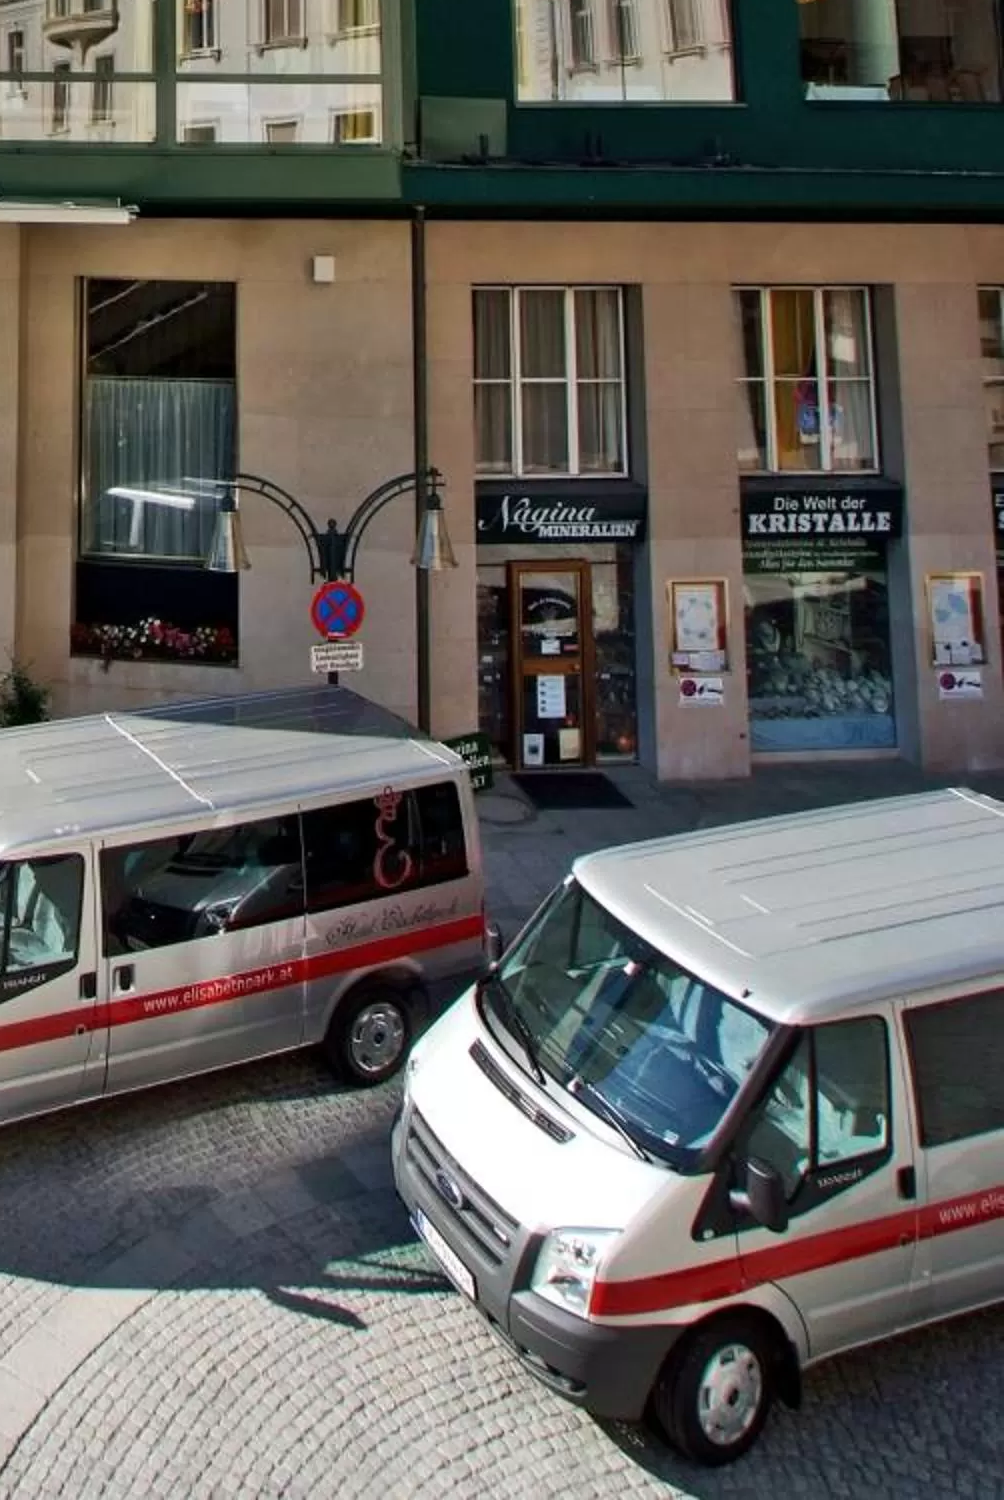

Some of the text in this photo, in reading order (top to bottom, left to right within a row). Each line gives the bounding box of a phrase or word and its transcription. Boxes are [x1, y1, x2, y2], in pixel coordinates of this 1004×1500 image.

[478, 495, 596, 533] Nagina
[773, 496, 866, 511] Die Welt der
[538, 520, 639, 538] MINERALIEN
[748, 511, 892, 534] KRISTALLE
[143, 965, 293, 1013] www.elisabethpark.at
